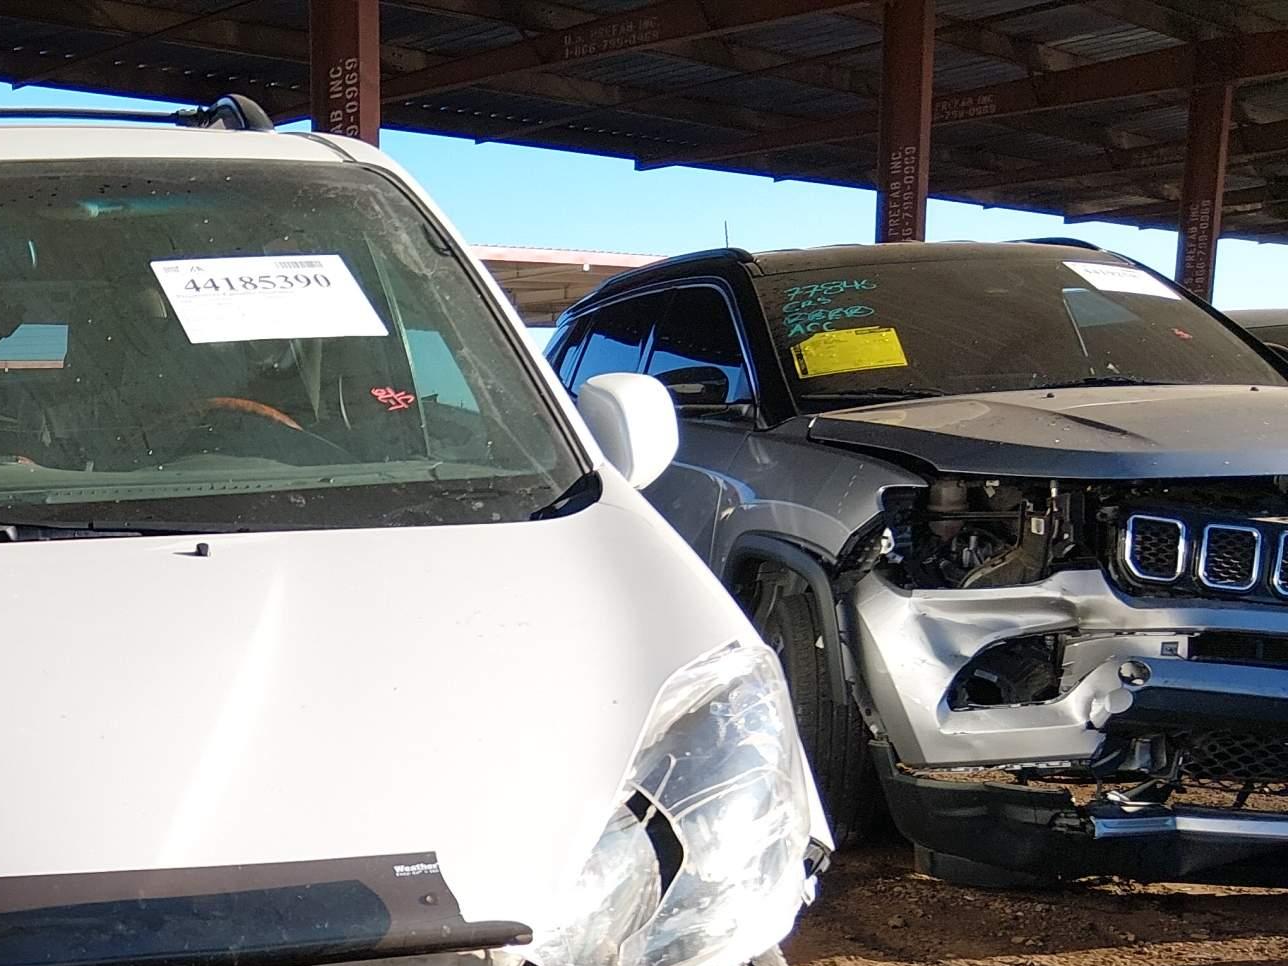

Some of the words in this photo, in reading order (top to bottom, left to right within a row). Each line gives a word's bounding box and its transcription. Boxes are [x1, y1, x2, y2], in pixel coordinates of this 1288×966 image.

[328, 58, 343, 99] INC.
[890, 146, 903, 174] INC.
[888, 181, 901, 236] PREFAB
[184, 273, 332, 293] 44185390
